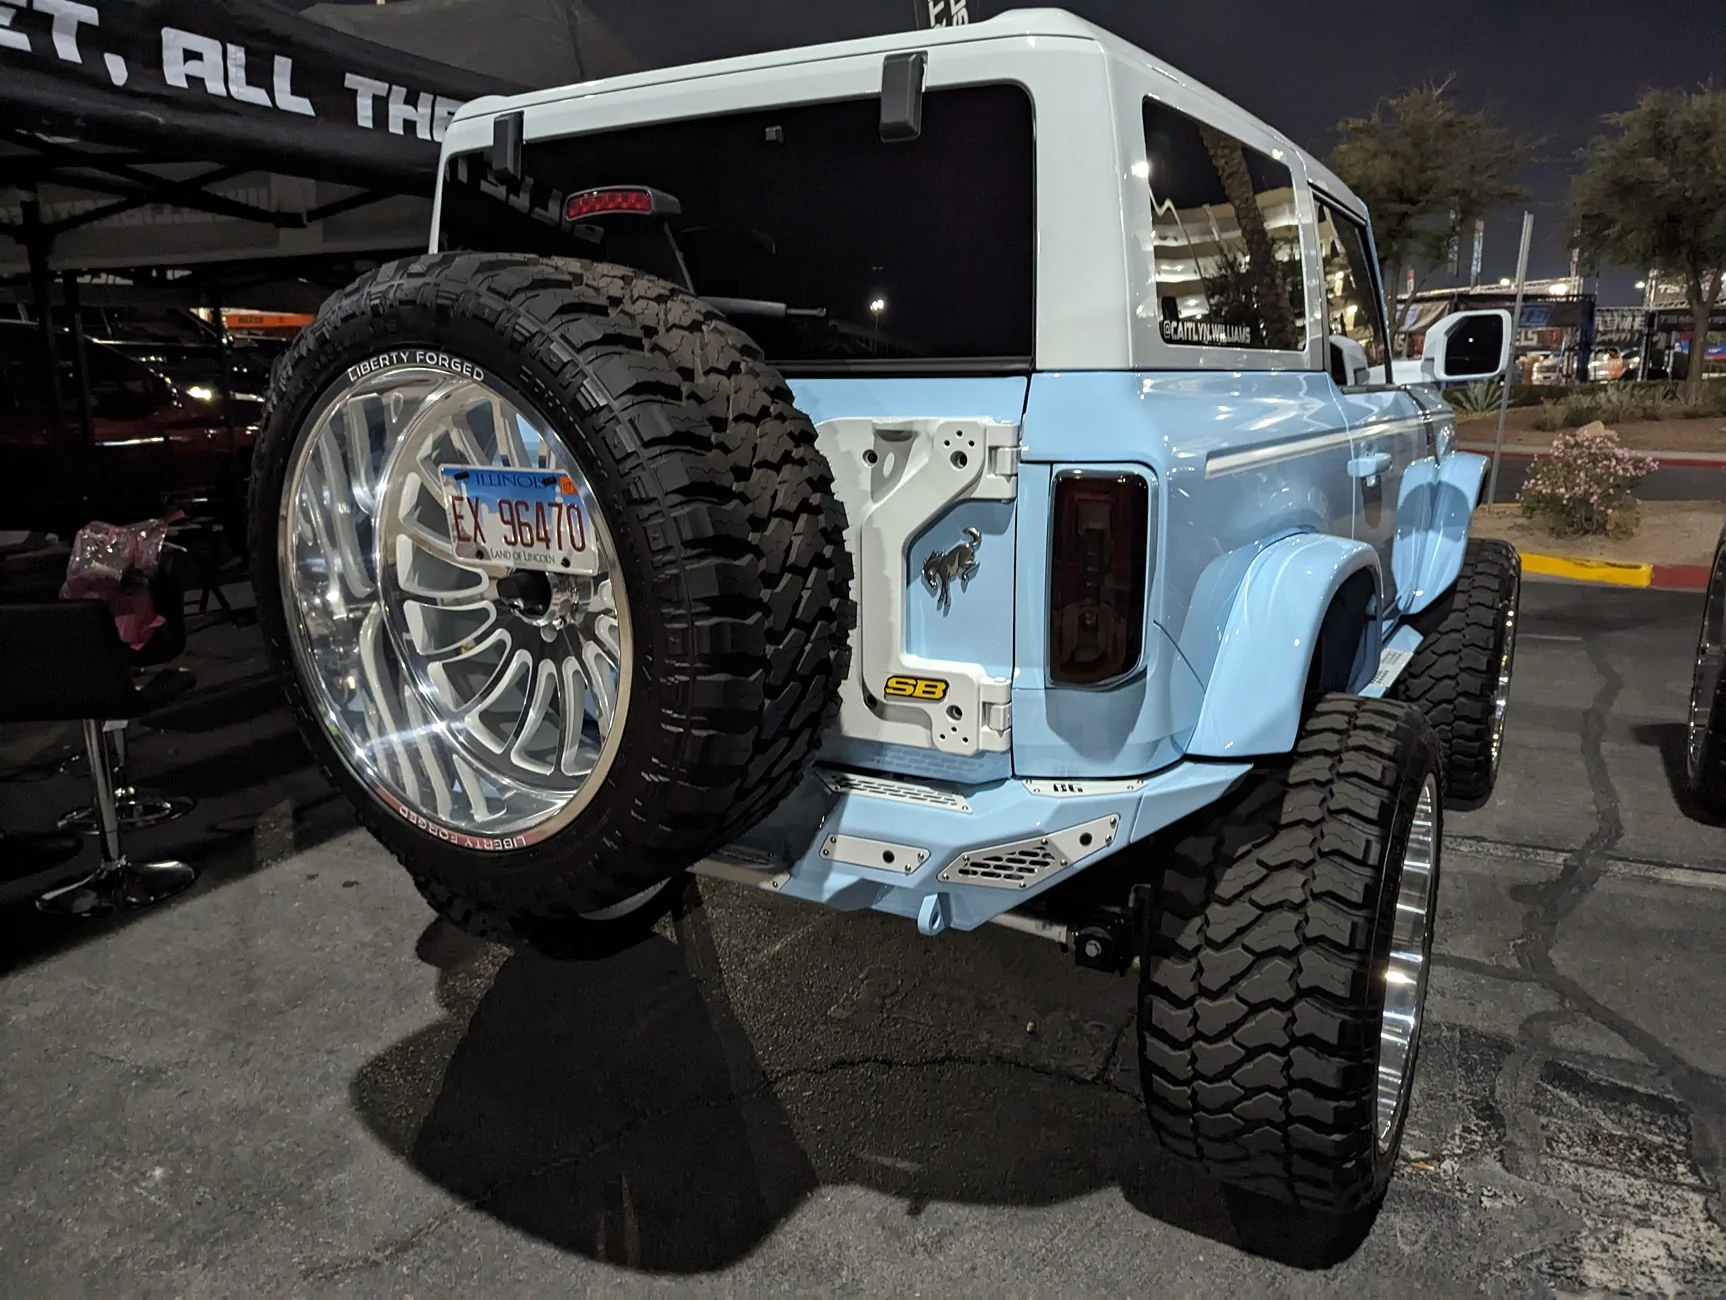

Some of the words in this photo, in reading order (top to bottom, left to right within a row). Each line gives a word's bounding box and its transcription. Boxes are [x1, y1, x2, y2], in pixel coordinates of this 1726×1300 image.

[161, 26, 316, 118] ALL
[1163, 320, 1251, 344] @CAITLYN.WILLIAMS
[348, 351, 409, 382] LIBERTY
[416, 351, 484, 382] FORGED
[452, 495, 487, 544] EX
[498, 498, 586, 552] 96470
[490, 548, 512, 559] LAND
[513, 551, 522, 561] OF
[523, 552, 555, 564] LINCOLN
[884, 675, 949, 700] SB
[400, 806, 458, 843] FORGED
[464, 836, 527, 849] LIBERTY
